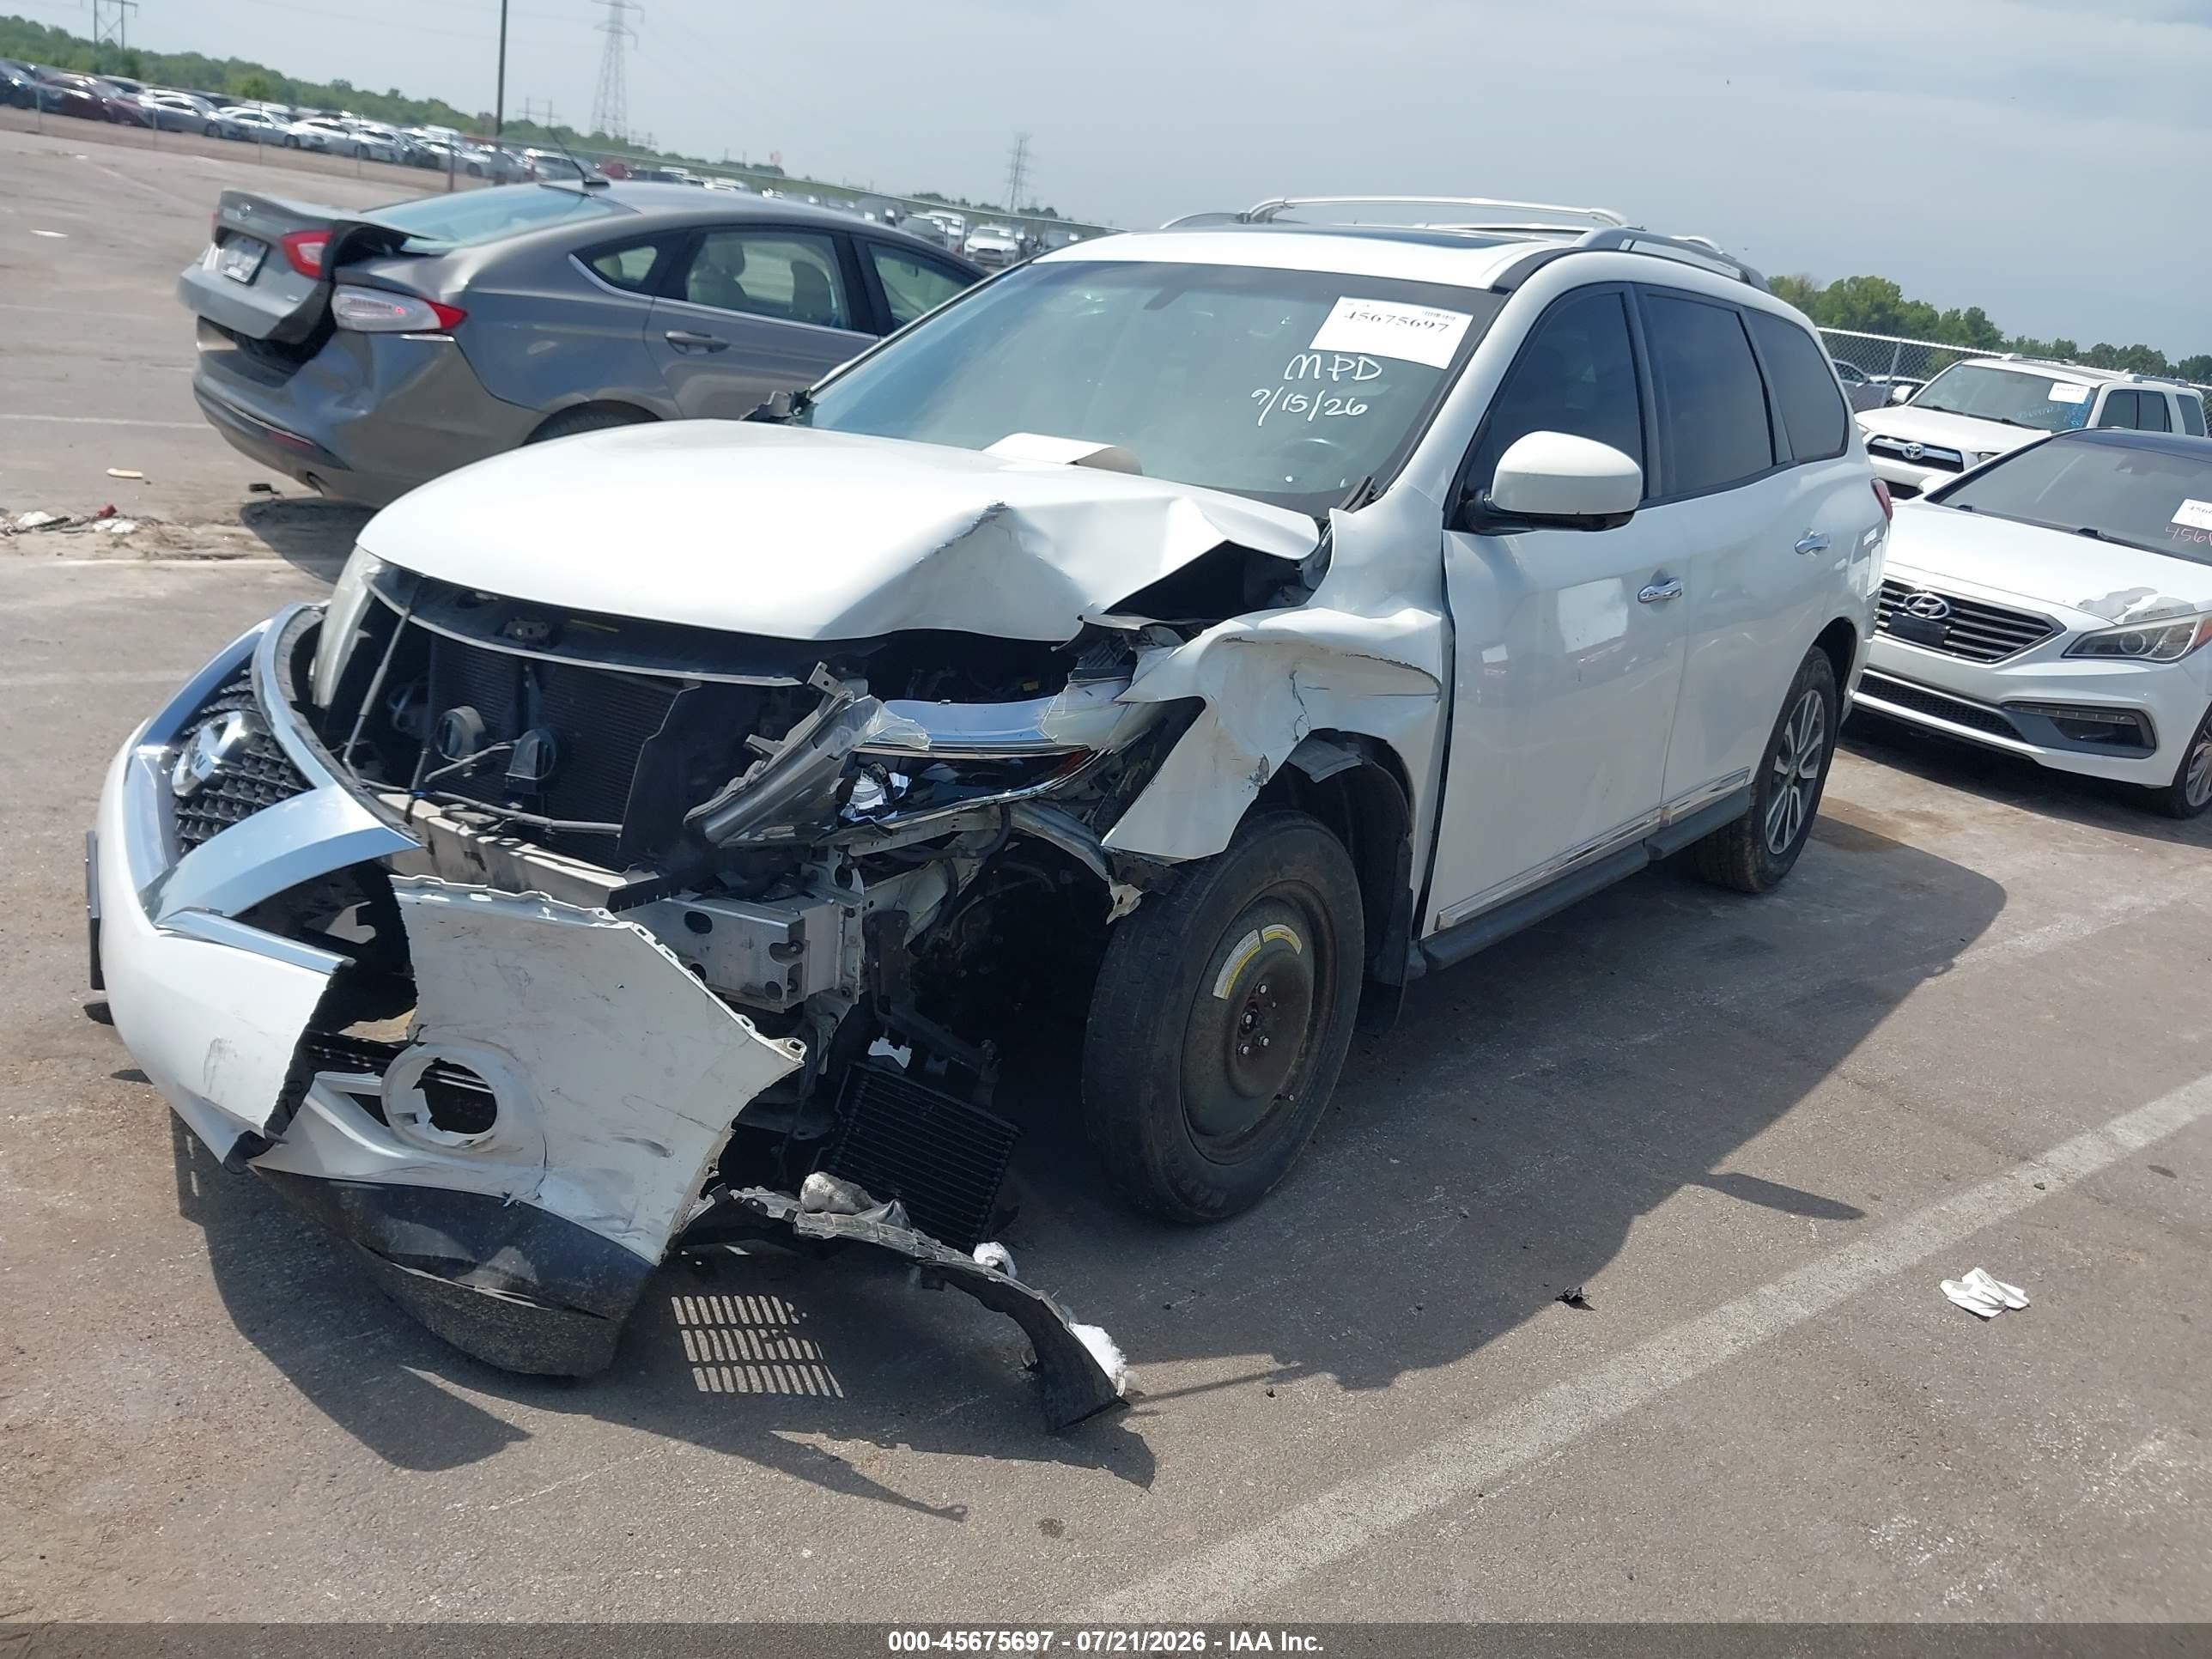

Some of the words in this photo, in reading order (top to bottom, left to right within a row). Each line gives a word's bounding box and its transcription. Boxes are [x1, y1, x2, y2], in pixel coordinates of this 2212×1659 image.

[1344, 310, 1449, 333] 45675697
[1283, 354, 1382, 381] MPD
[2165, 526, 2212, 546] 456
